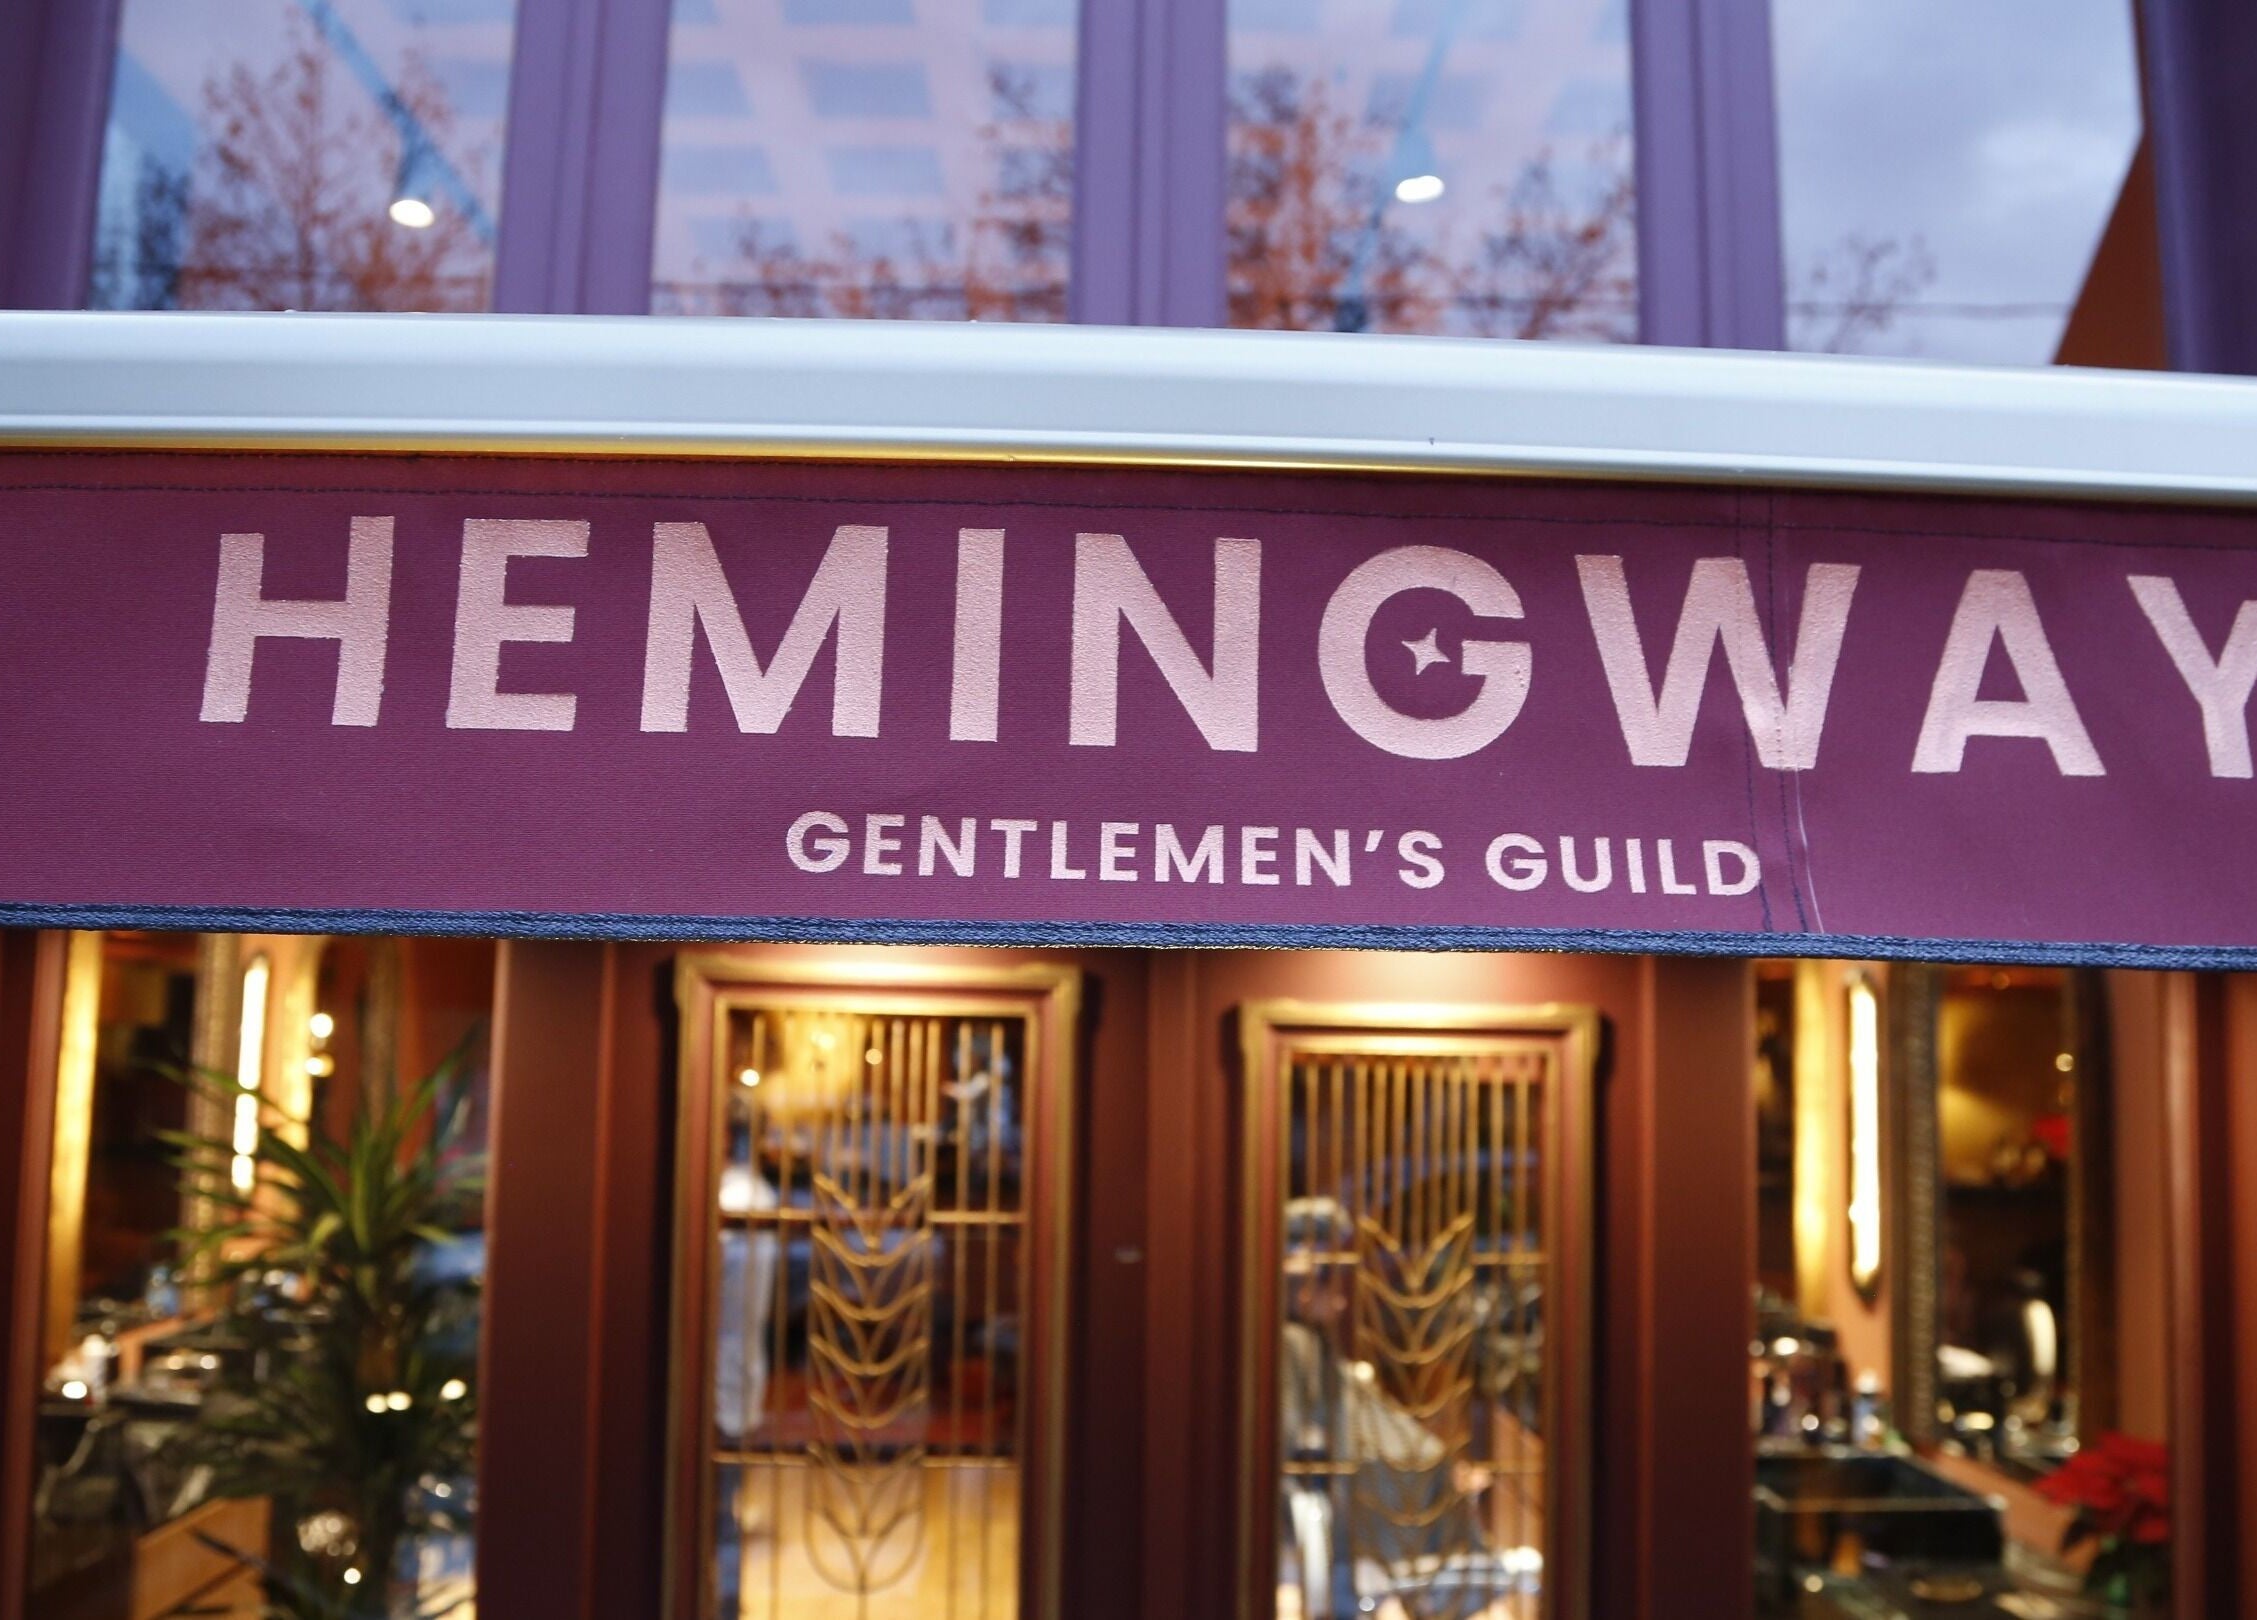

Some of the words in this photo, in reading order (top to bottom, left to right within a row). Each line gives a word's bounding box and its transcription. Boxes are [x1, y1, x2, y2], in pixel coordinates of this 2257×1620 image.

[198, 514, 2257, 779] HEMINGWAY
[785, 810, 1446, 892] GENTLEMEN’S
[1484, 832, 1763, 898] GUILD
